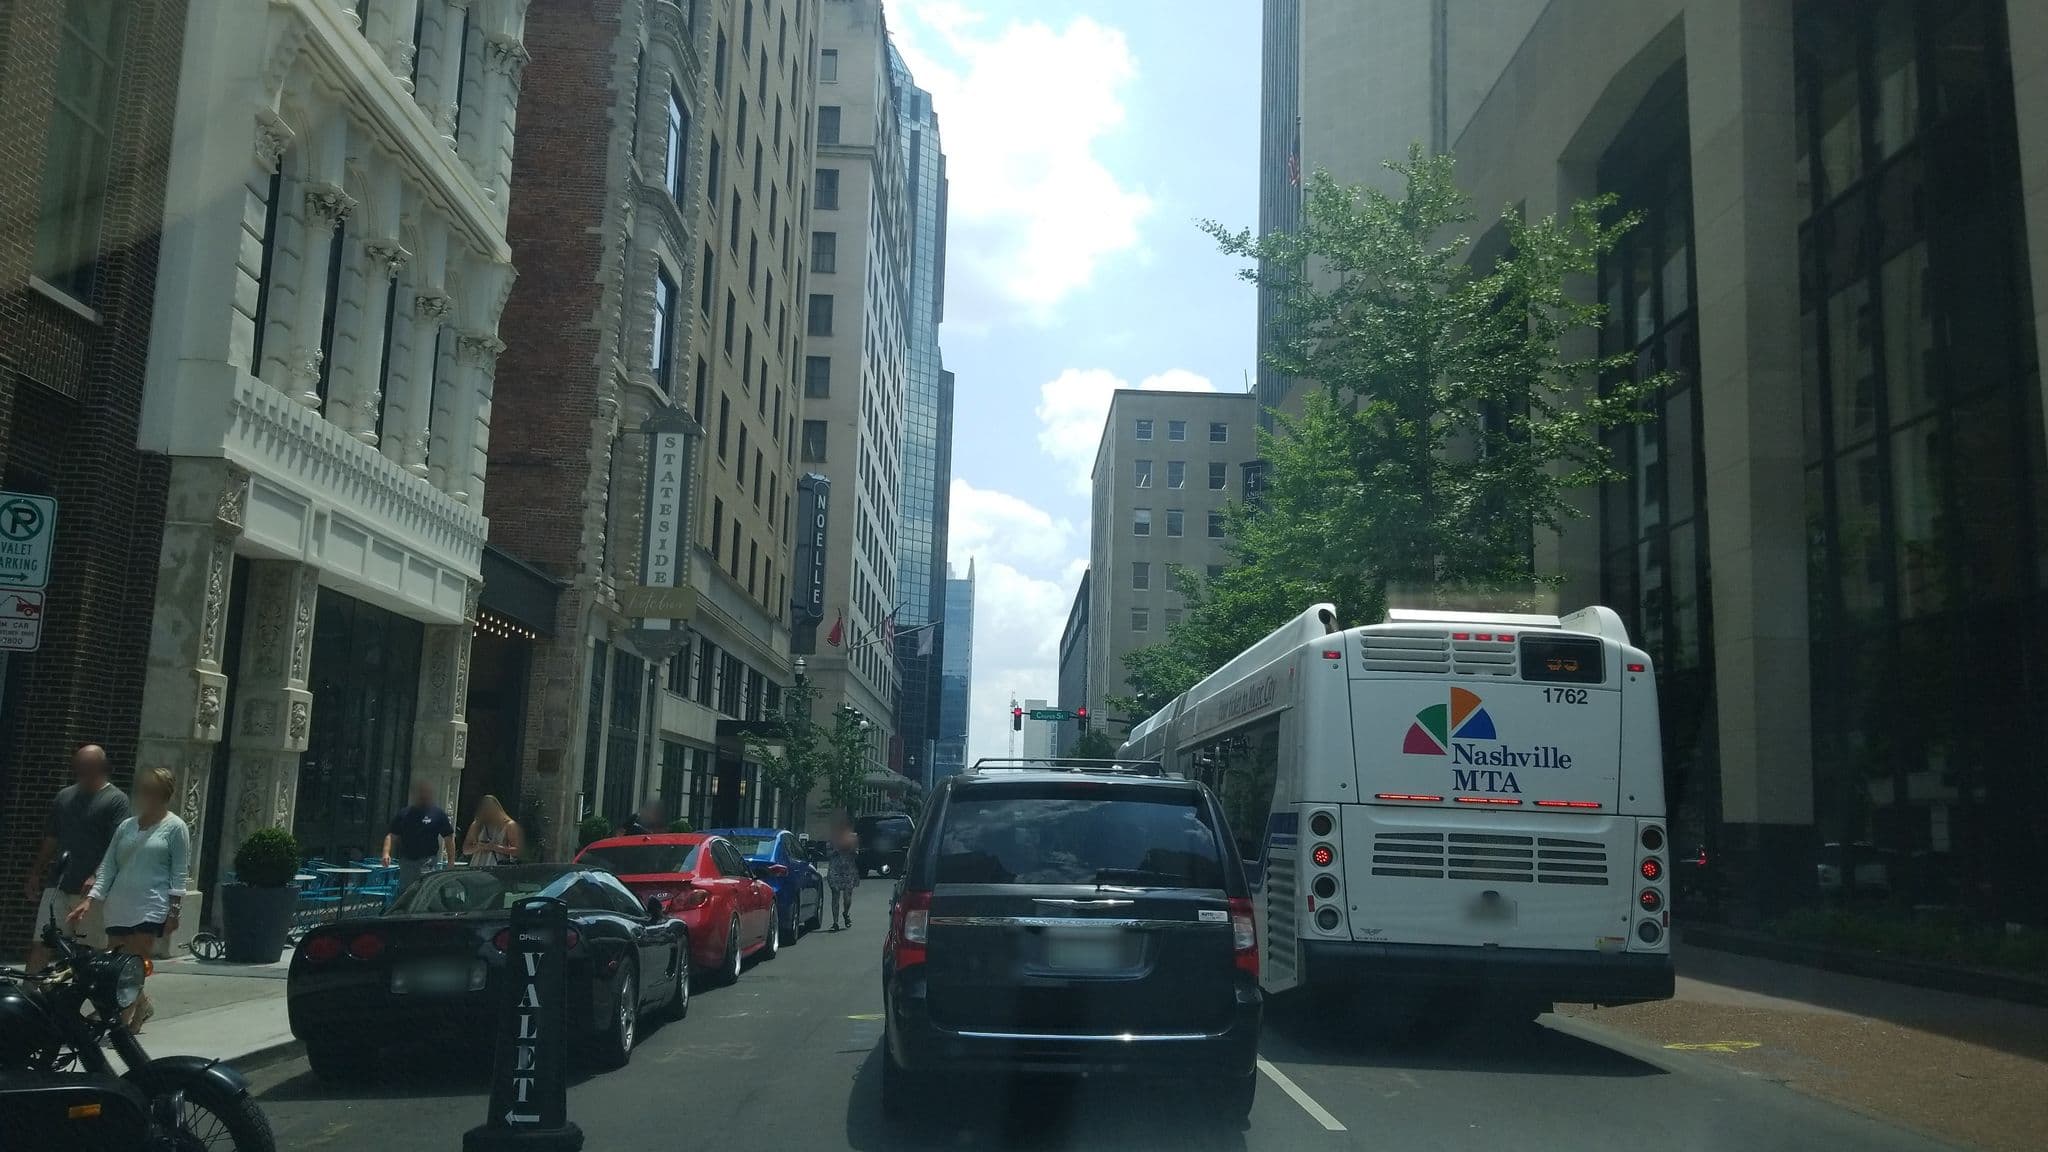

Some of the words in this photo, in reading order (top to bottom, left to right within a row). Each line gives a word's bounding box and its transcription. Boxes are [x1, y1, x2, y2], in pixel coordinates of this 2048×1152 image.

[654, 437, 676, 584] STATESIDE
[1, 542, 32, 556] VALET
[813, 495, 826, 604] NOELLE
[0, 556, 38, 571] ARKING
[1543, 688, 1588, 704] 1762
[1451, 743, 1572, 769] Nashville
[1452, 769, 1522, 793] MTA
[513, 952, 545, 1102] VALET
